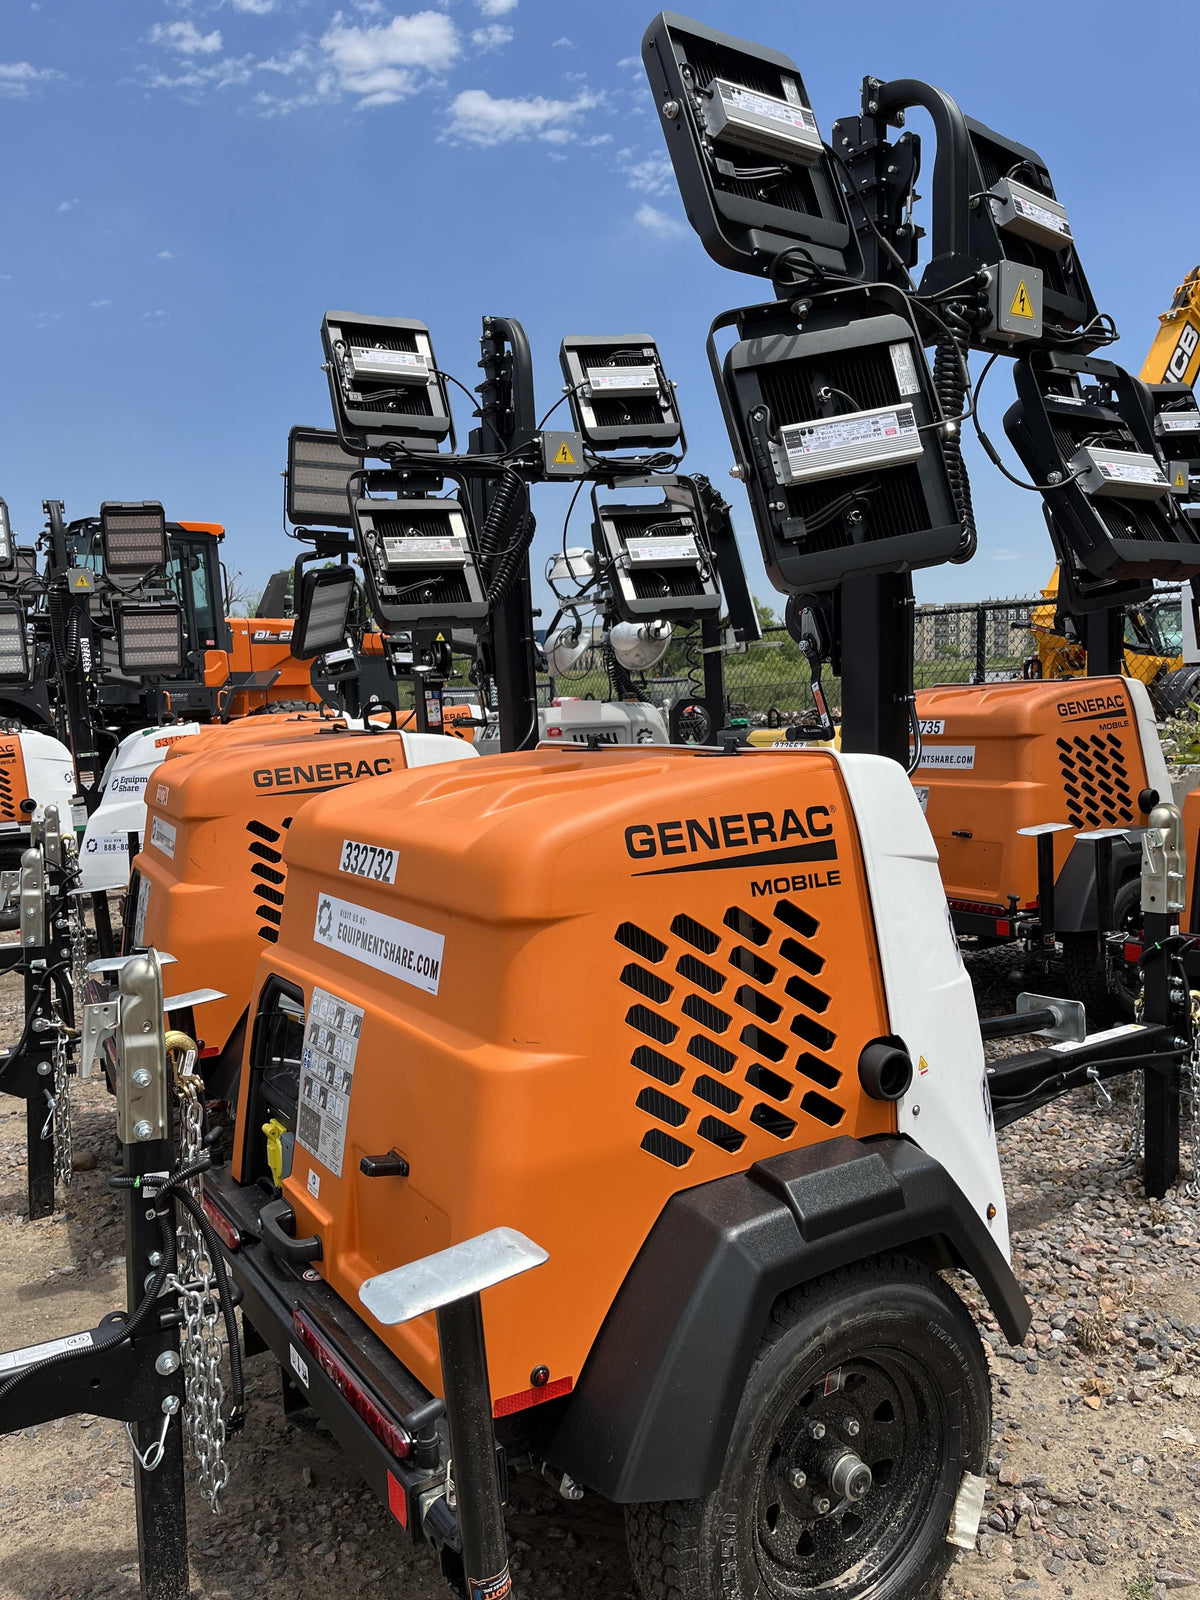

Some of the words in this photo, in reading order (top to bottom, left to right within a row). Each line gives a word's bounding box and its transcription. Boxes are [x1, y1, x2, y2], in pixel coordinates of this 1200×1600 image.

[1057, 695, 1125, 717] GENERAC
[1099, 720, 1130, 731] MOBILE
[253, 758, 393, 788] GENERAC
[624, 805, 834, 860] GENERAC
[342, 841, 394, 883] 332732
[751, 870, 842, 897] MOBILE
[340, 908, 352, 921] VISIT
[352, 913, 359, 923] US
[337, 922, 440, 981] EQUIPMENTSHARE.COM
